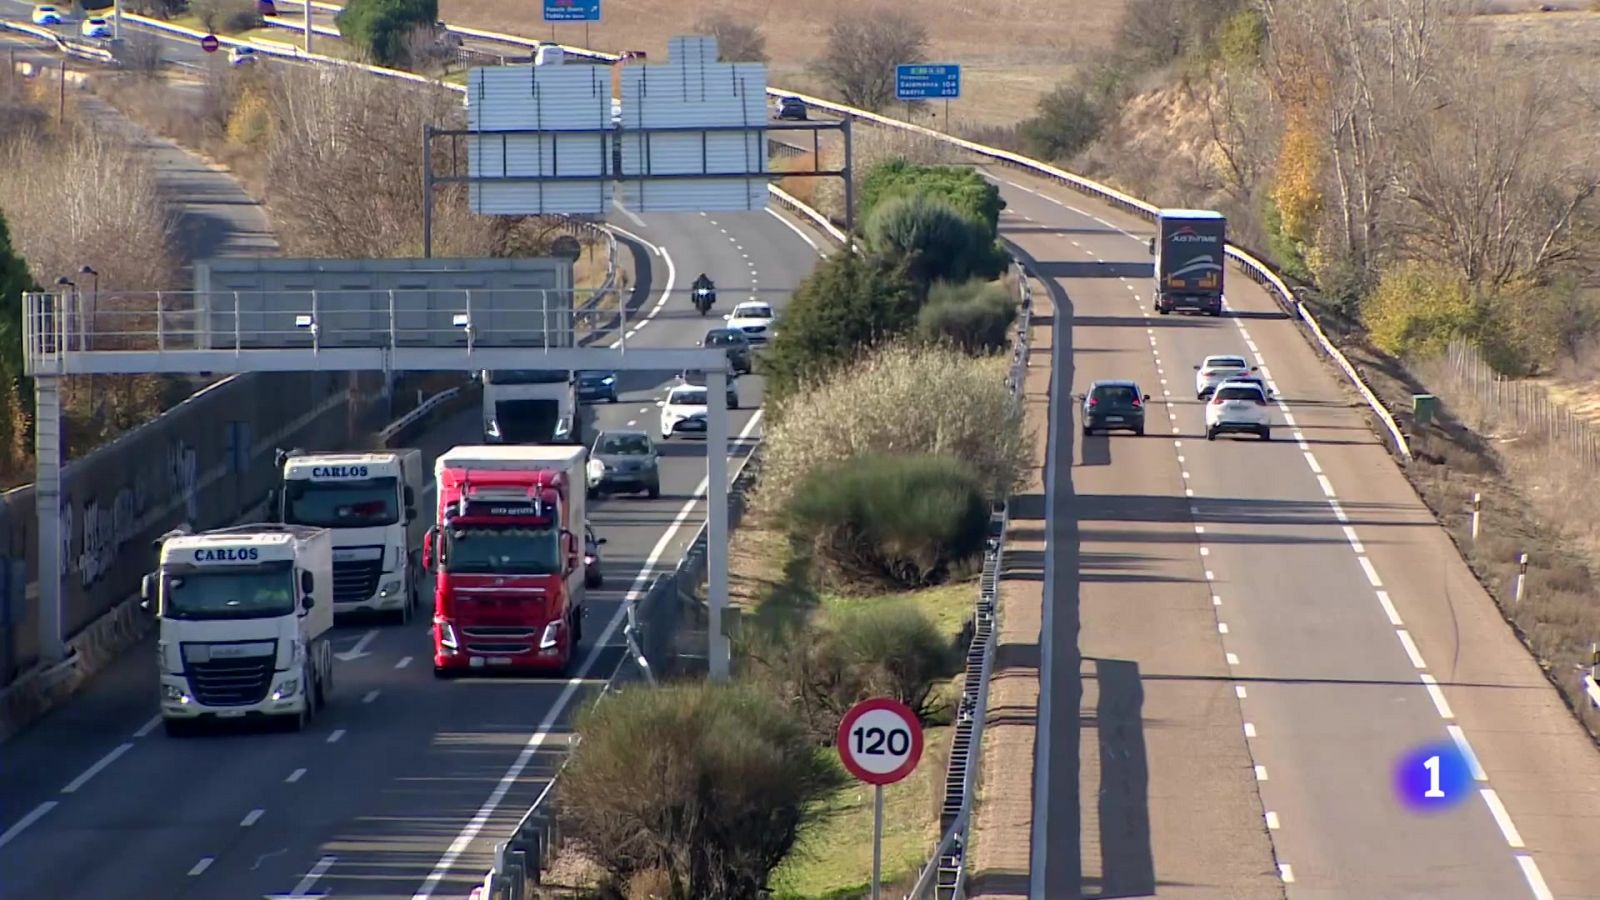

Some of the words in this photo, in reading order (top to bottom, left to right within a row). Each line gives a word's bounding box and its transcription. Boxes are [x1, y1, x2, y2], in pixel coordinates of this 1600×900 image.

[312, 466, 368, 477] CARLOS
[194, 548, 258, 561] CARLOS
[853, 727, 910, 756] 120
